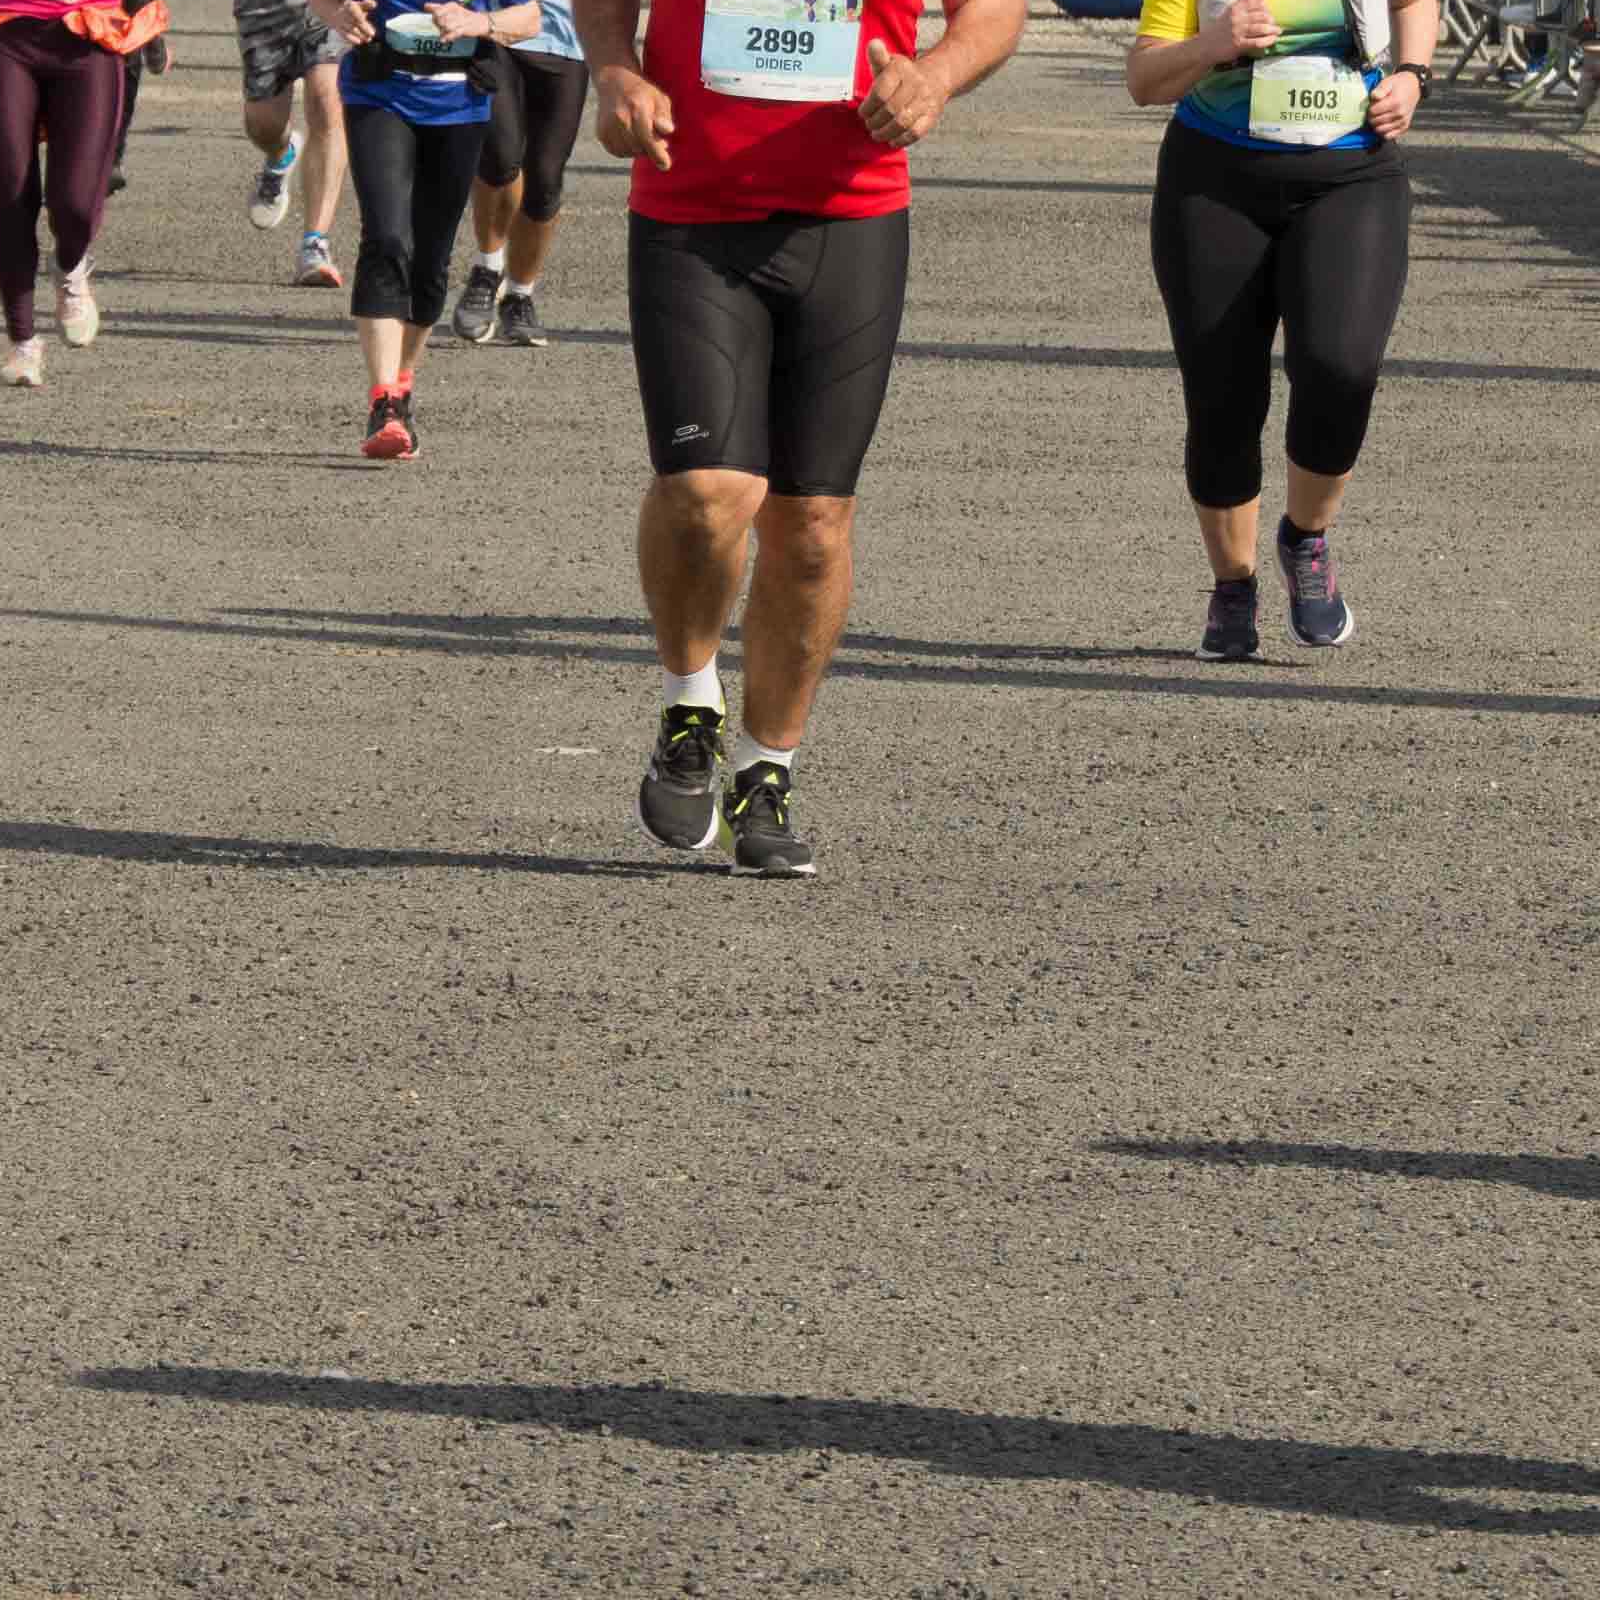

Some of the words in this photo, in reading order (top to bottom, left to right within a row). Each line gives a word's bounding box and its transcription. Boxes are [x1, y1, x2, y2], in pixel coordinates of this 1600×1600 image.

[746, 26, 816, 56] 2899
[754, 56, 804, 72] DIDIER
[1287, 87, 1339, 110] 1603
[1279, 110, 1345, 122] STEPHANIE
